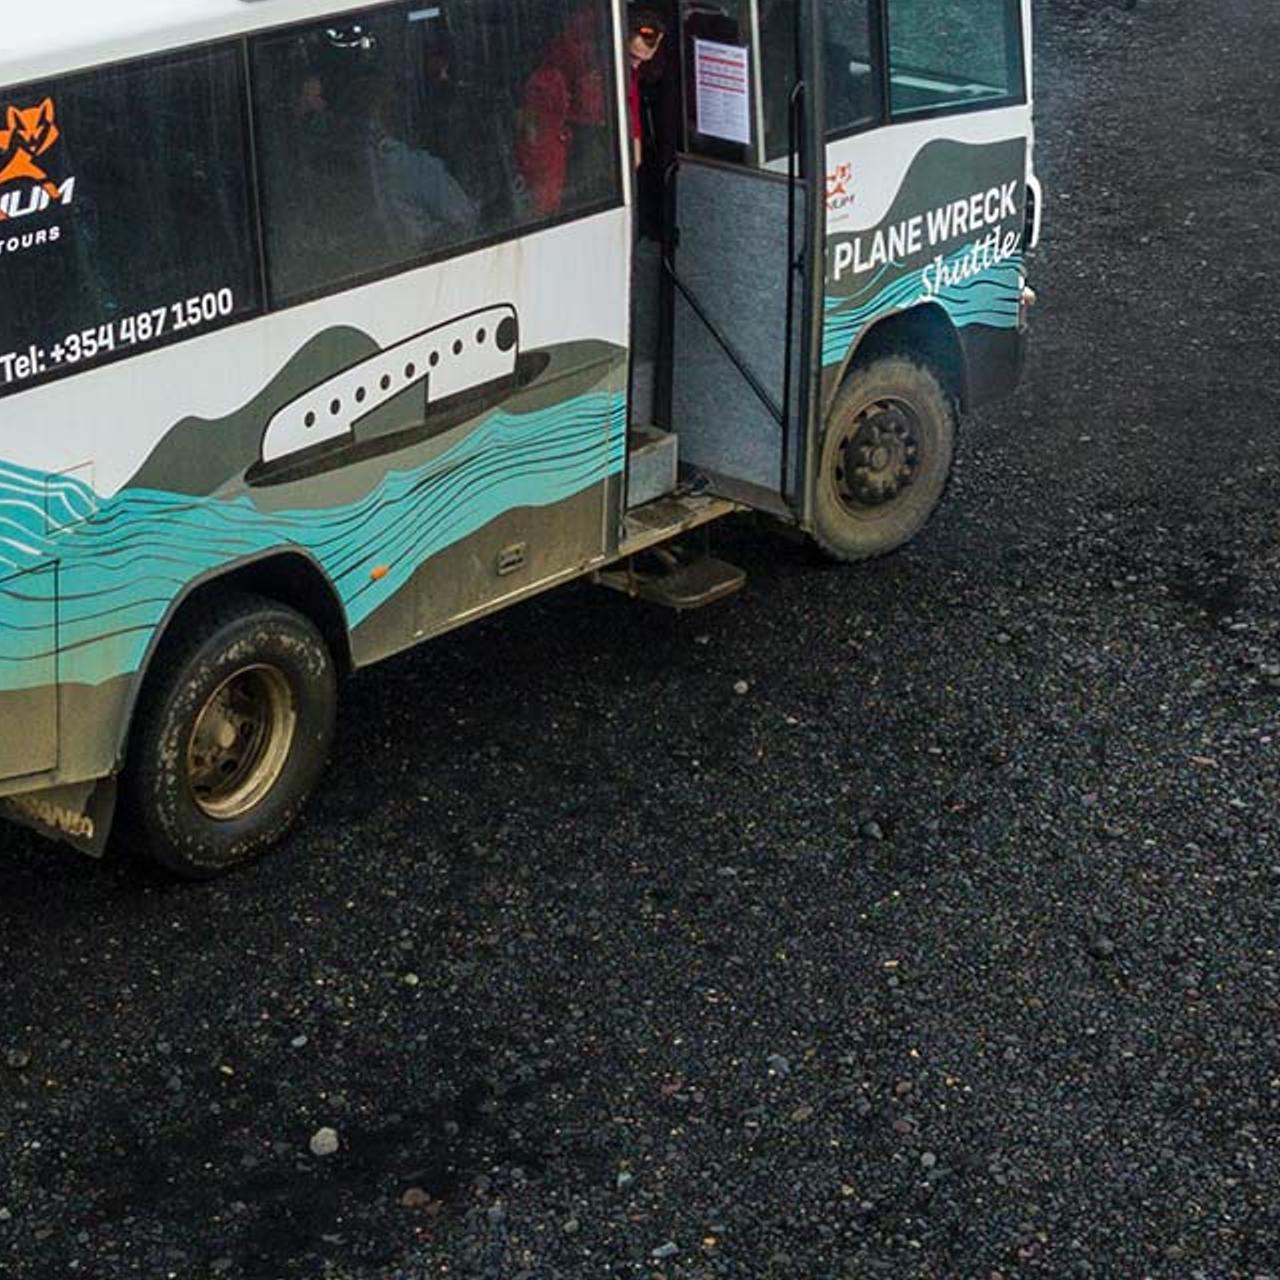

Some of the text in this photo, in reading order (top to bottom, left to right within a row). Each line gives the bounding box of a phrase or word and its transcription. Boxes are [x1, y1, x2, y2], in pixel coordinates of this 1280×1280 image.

[833, 215, 923, 281] PLANE
[926, 180, 1019, 246] WRECK
[920, 225, 1021, 298] Shuttle
[50, 322, 116, 367] +354
[119, 307, 167, 347] 487
[172, 287, 234, 331] 1500
